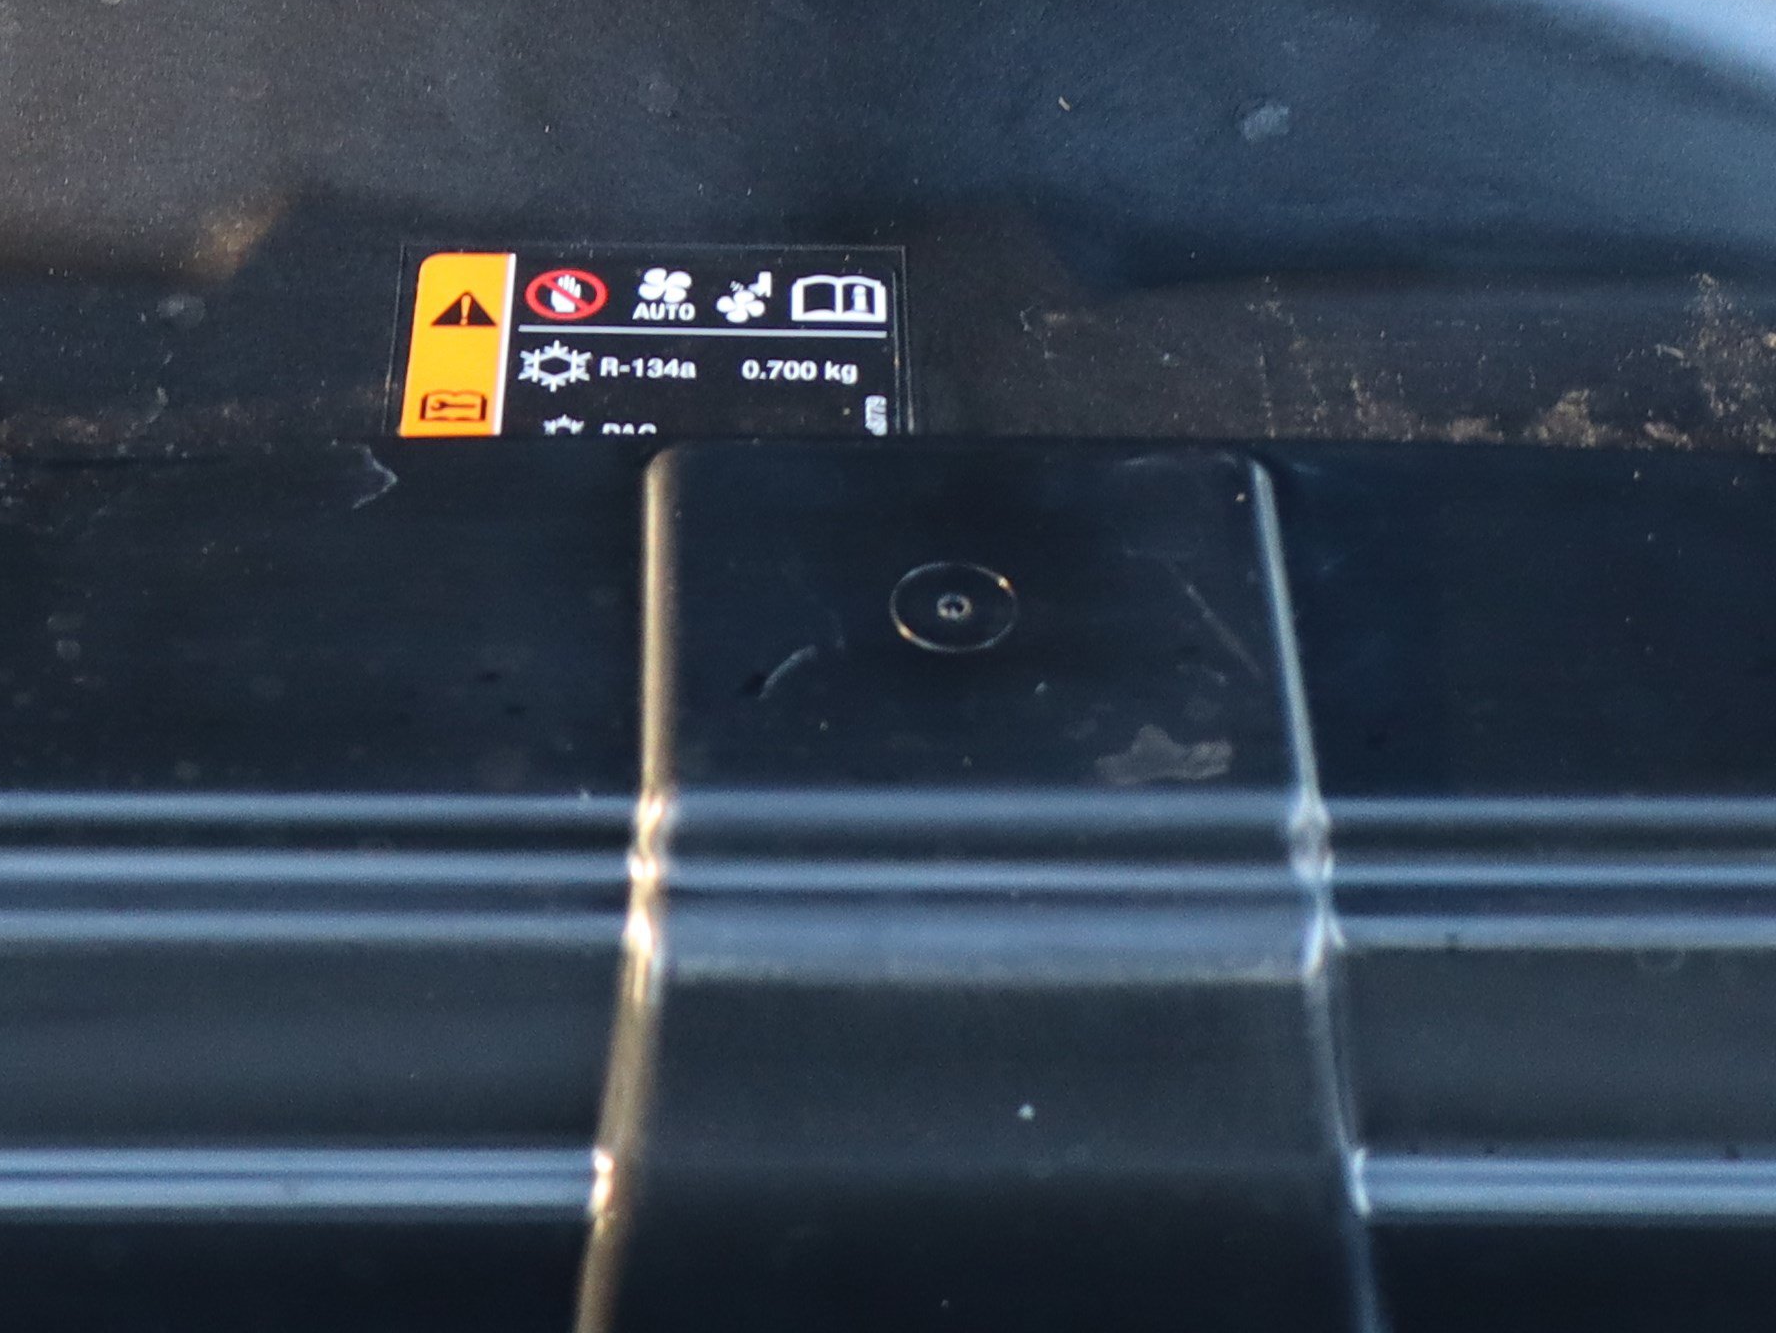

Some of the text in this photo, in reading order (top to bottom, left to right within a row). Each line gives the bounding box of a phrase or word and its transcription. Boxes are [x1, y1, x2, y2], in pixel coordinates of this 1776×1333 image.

[632, 301, 696, 322] AUTO
[599, 356, 859, 385] R-134a 0.700 kg
